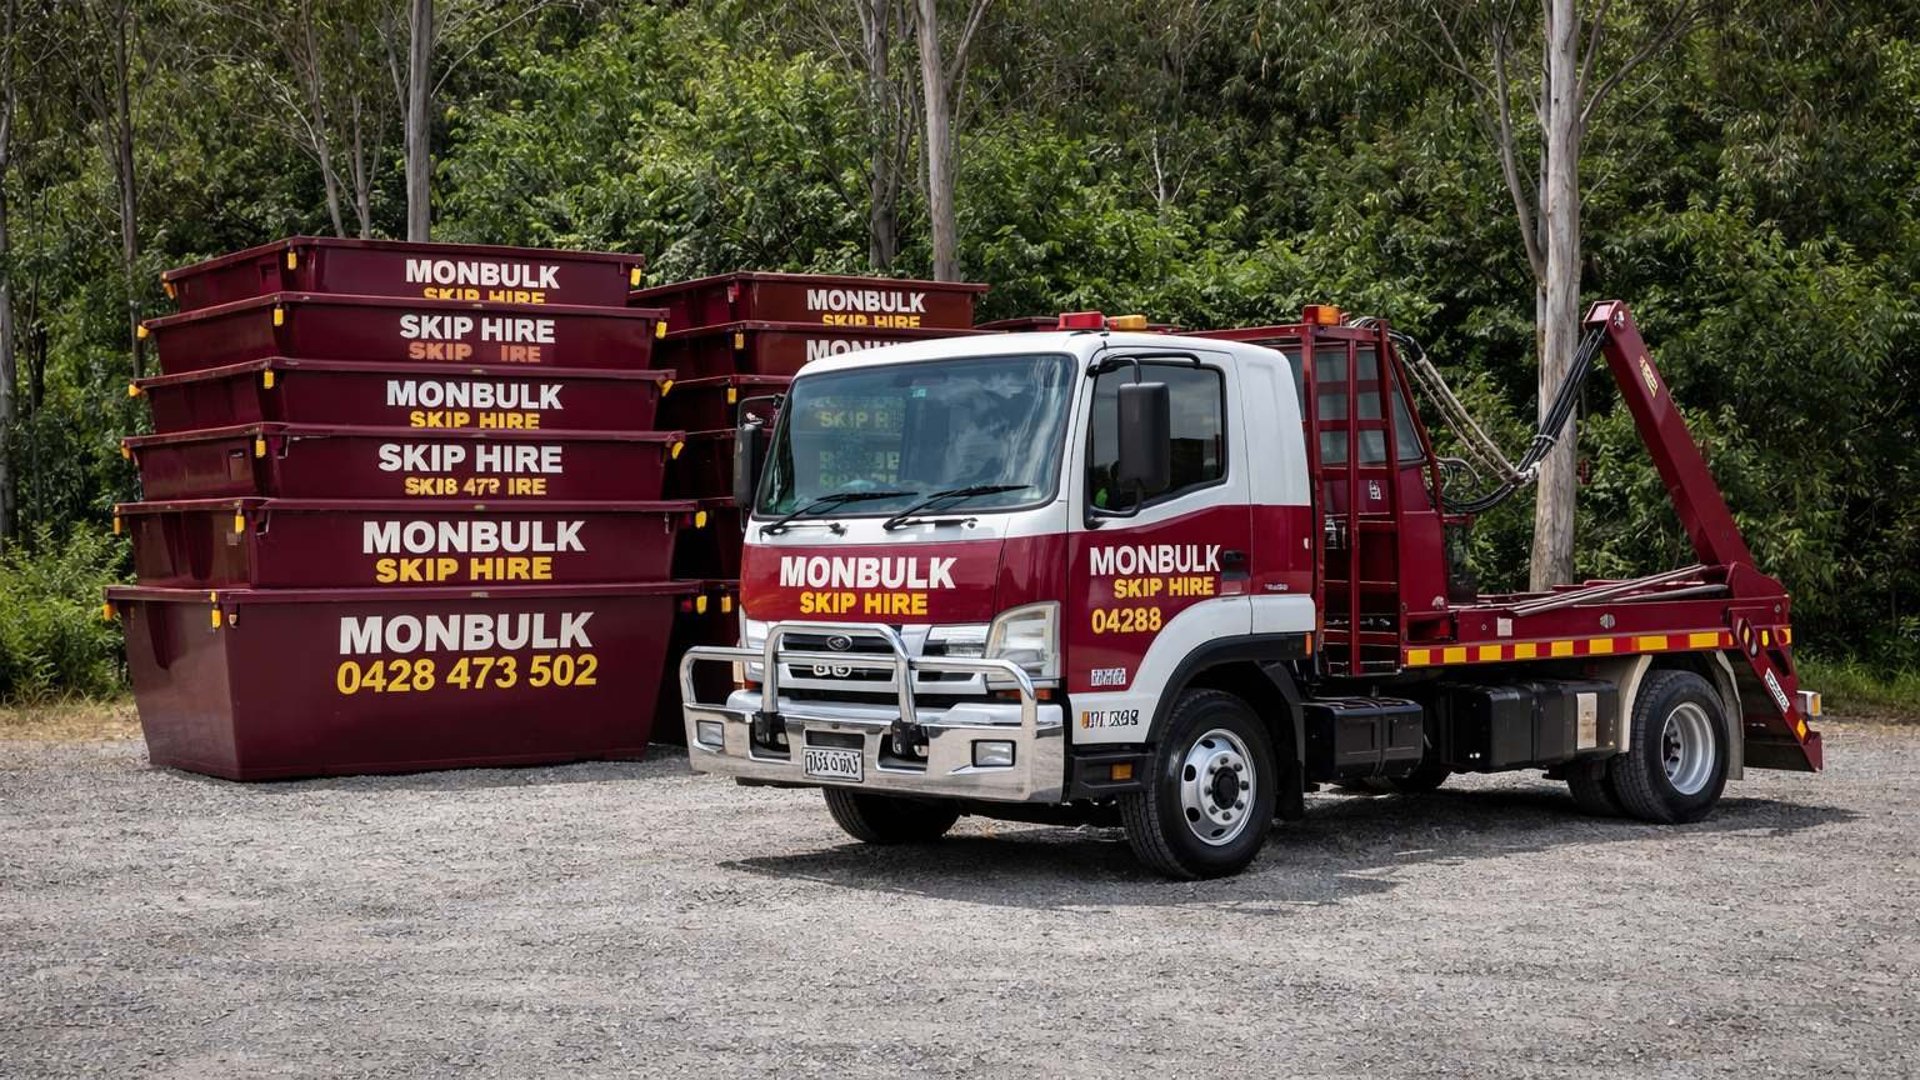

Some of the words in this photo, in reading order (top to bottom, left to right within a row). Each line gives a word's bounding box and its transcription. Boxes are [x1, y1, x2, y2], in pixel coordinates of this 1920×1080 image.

[406, 259, 560, 289] MONBULK
[423, 287, 480, 300] SKIP
[488, 290, 546, 304] HIRE
[807, 289, 925, 313] MONBULK
[400, 314, 474, 340] SKIP
[481, 317, 555, 343] HIRE
[409, 342, 473, 361] SKIP
[386, 380, 563, 410] MONBULK
[410, 410, 470, 428] SKIP
[479, 412, 541, 430] HIRE
[378, 443, 466, 472] SKIP
[475, 445, 563, 473] HIRE
[363, 520, 586, 554] MONBULK
[375, 557, 459, 583] SKIP
[469, 556, 553, 581] HIRE
[779, 556, 957, 589] MONBULK
[1090, 545, 1221, 576] MONBULK
[1114, 578, 1163, 599] SKIP
[1168, 576, 1215, 596] HIRE
[800, 591, 857, 614] SKIP
[864, 593, 928, 615] HIRE
[339, 611, 594, 655] MONBULK
[1091, 607, 1162, 634] 04288
[337, 659, 436, 695] 0428
[446, 656, 518, 690] 473
[529, 654, 598, 688] 502
